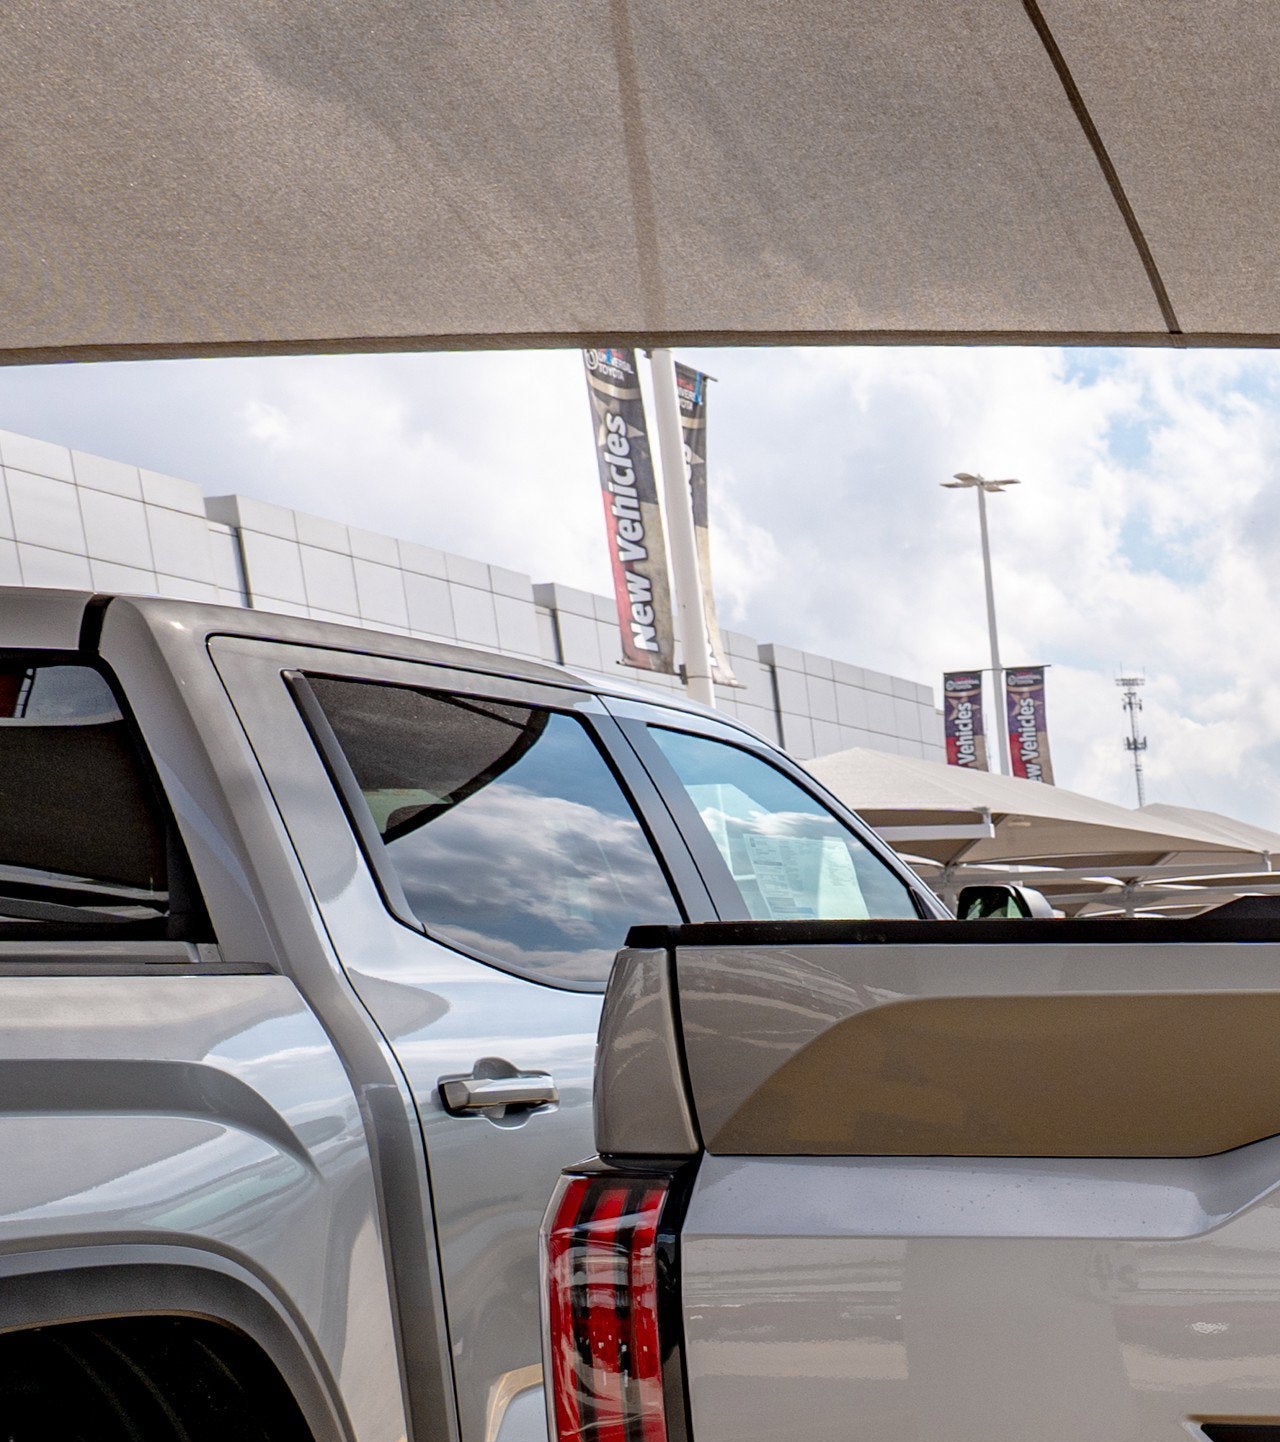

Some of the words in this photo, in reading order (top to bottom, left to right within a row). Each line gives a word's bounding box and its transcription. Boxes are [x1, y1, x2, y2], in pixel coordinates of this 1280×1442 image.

[603, 412, 649, 564] Vehicles
[625, 570, 660, 653] New
[954, 702, 976, 765] Vehicles
[1017, 698, 1039, 761] Vehicles
